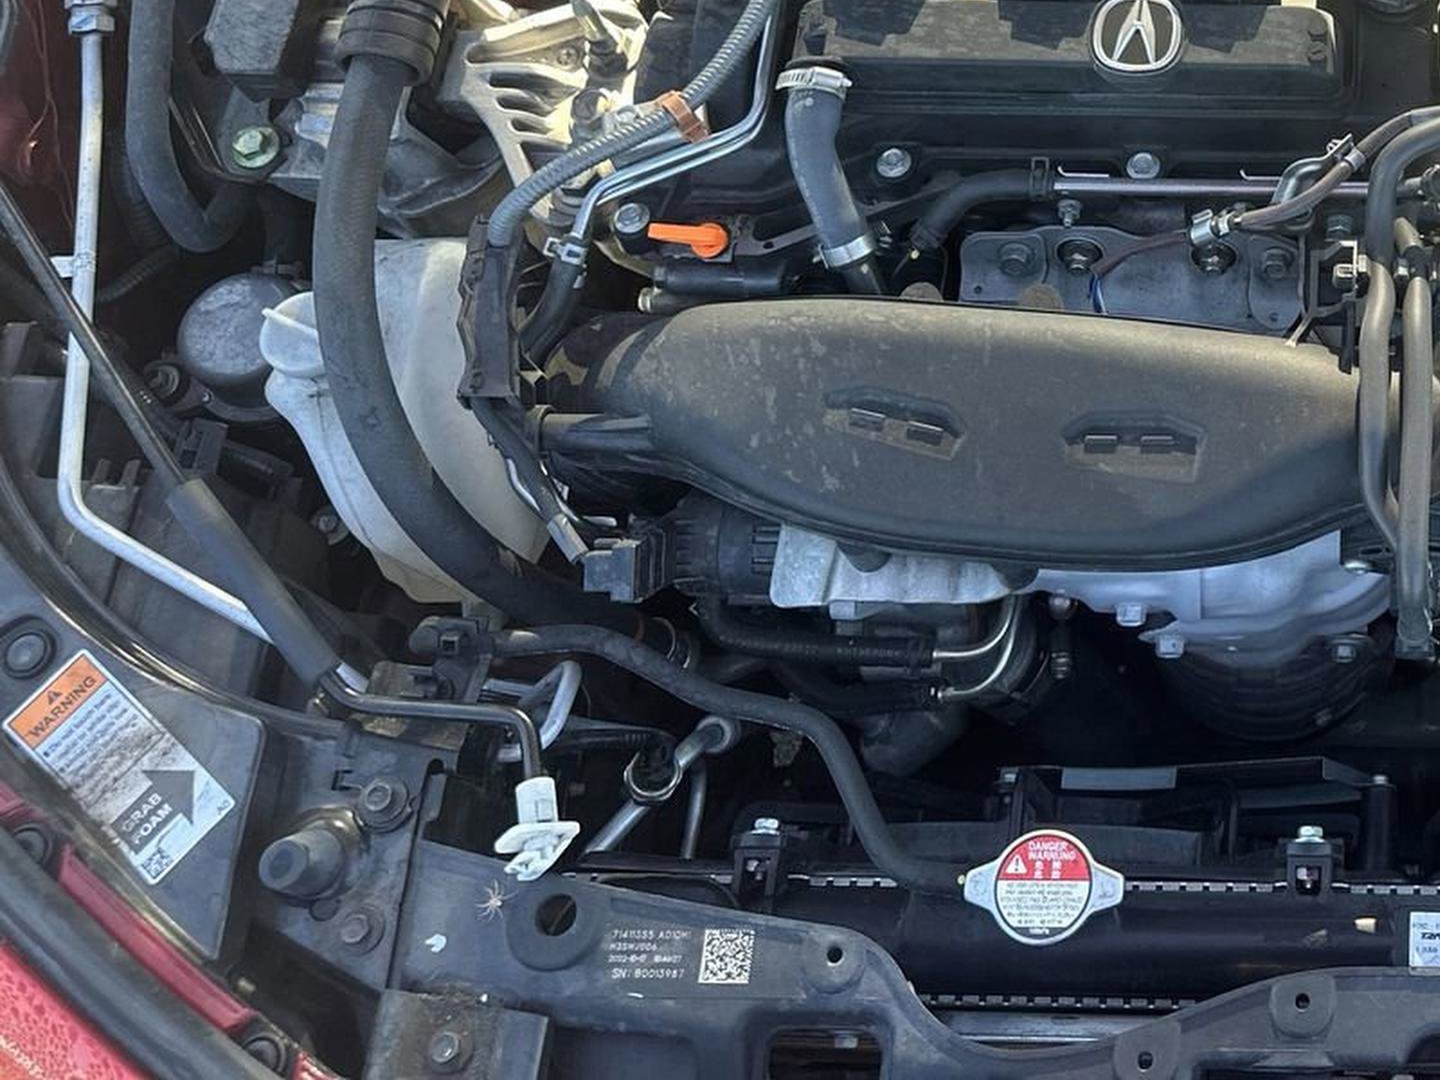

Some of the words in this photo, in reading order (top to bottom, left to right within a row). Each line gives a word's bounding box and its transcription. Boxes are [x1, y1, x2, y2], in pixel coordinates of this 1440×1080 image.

[28, 676, 97, 737] WARNING
[122, 793, 162, 832] GRAB
[132, 803, 173, 844] FOAM
[1028, 841, 1068, 851] DANGER
[1028, 850, 1076, 861] WARNING
